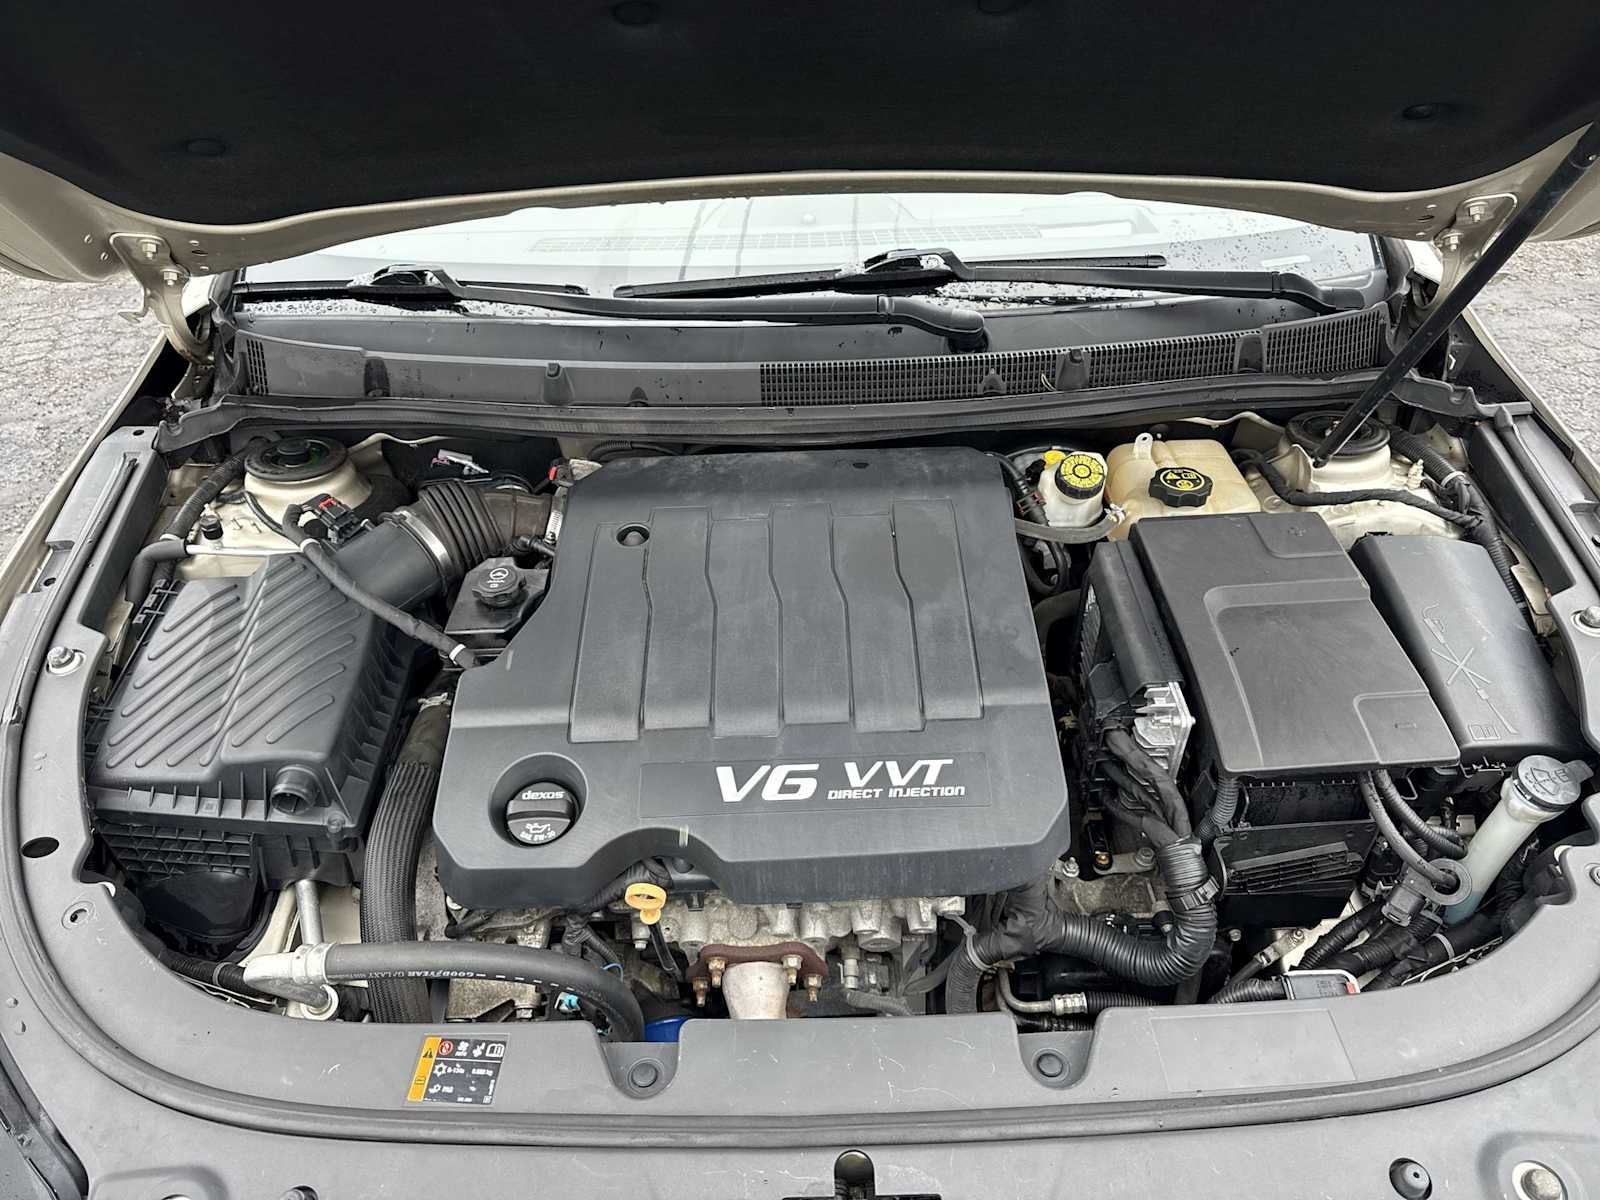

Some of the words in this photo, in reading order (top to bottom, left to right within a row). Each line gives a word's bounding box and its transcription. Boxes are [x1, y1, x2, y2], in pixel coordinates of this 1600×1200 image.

[715, 763, 820, 803] V6
[843, 758, 954, 788] VVT
[521, 790, 565, 800] dexos
[827, 788, 883, 800] DIRECT
[888, 786, 966, 799] INJECTION
[407, 969, 474, 978] GOODYEAR
